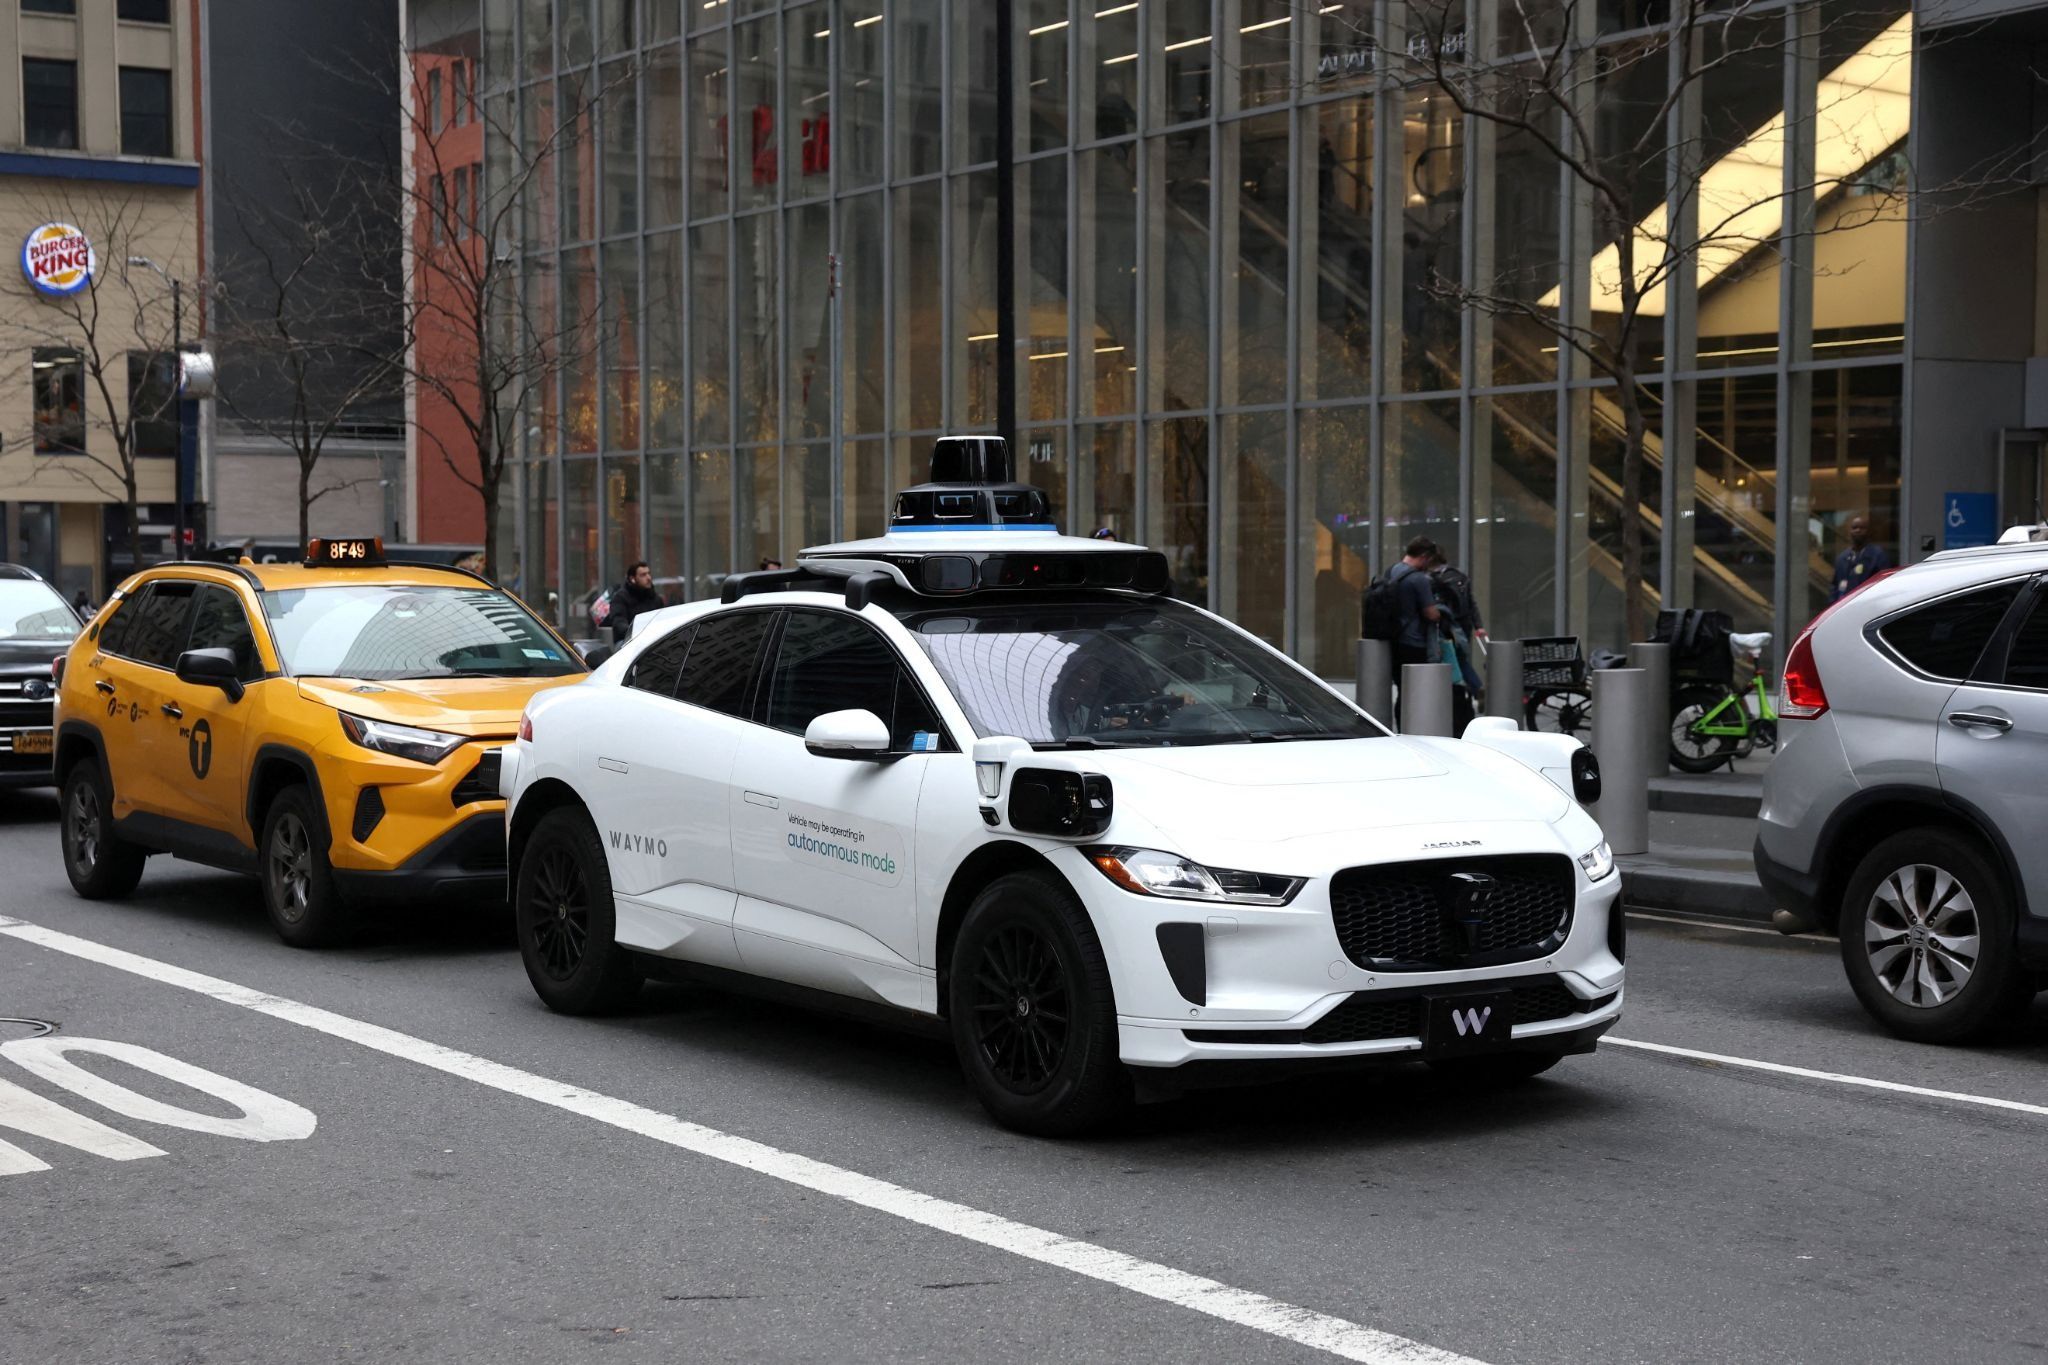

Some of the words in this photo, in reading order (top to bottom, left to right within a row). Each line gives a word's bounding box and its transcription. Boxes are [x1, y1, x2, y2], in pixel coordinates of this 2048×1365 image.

[30, 236, 86, 260] BURGER
[34, 249, 88, 278] KING
[330, 542, 366, 559] 8F49
[788, 812, 808, 827] Vehicle
[808, 819, 821, 833] may
[821, 820, 830, 833] be
[830, 825, 859, 843] operating
[859, 831, 865, 842] in
[609, 830, 667, 858] WAYMO
[787, 833, 859, 865] autonomous
[861, 852, 896, 874] mode
[1452, 1006, 1492, 1036] W
